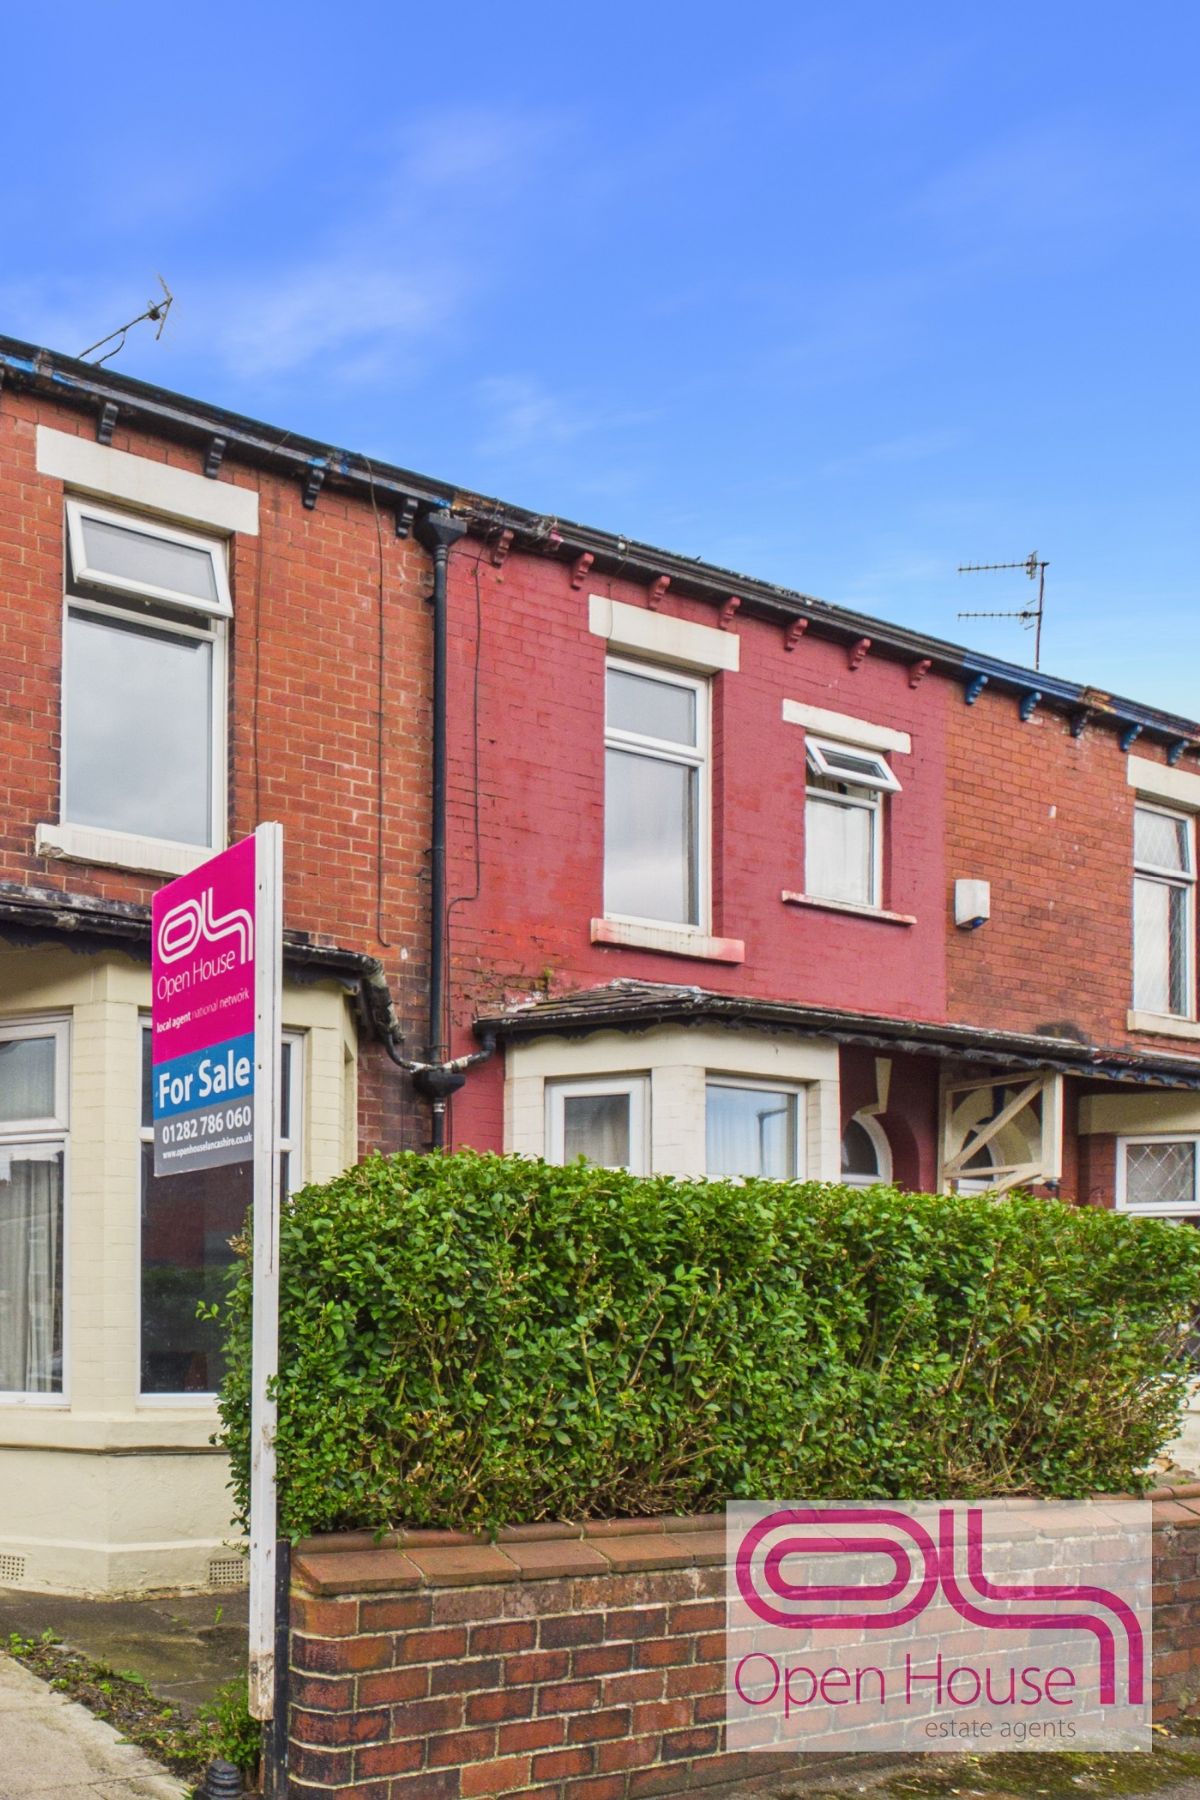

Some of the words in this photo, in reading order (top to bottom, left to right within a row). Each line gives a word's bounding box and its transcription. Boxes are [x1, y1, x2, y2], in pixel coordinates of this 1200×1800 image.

[157, 970, 190, 1003] Open
[193, 950, 236, 985] House
[156, 1017, 172, 1034] local
[172, 1011, 191, 1029] agent
[191, 998, 218, 1019] national
[219, 987, 250, 1009] network
[159, 1071, 194, 1109] For
[198, 1049, 251, 1097] Sale
[162, 1118, 198, 1144] 01282
[200, 1112, 224, 1136] 786
[226, 1105, 252, 1130] 060
[162, 1132, 253, 1160] www.openhouselancashire.co.uk
